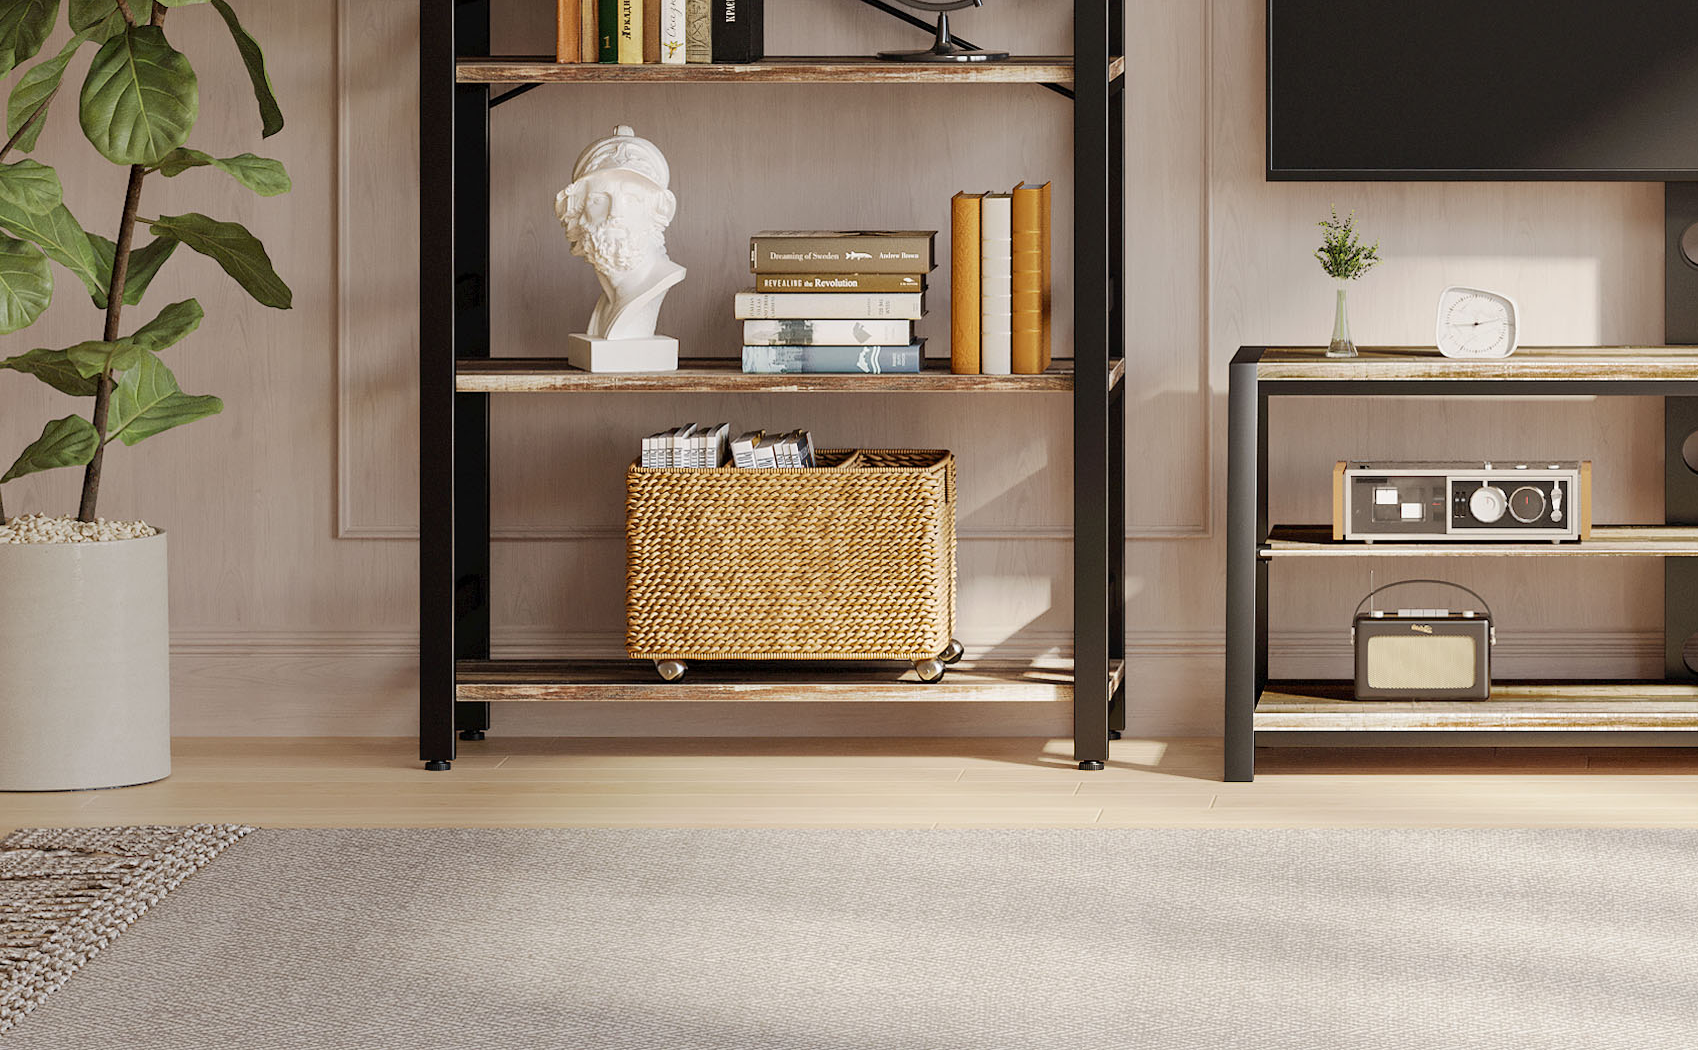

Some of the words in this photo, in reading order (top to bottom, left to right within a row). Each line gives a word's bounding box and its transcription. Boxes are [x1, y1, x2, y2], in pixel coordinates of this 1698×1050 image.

[769, 251, 803, 262] Dreaming
[804, 251, 813, 261] of
[812, 251, 840, 261] Sweden
[763, 278, 803, 288] REVEALING
[803, 279, 814, 288] the
[814, 277, 858, 288] Revolution
